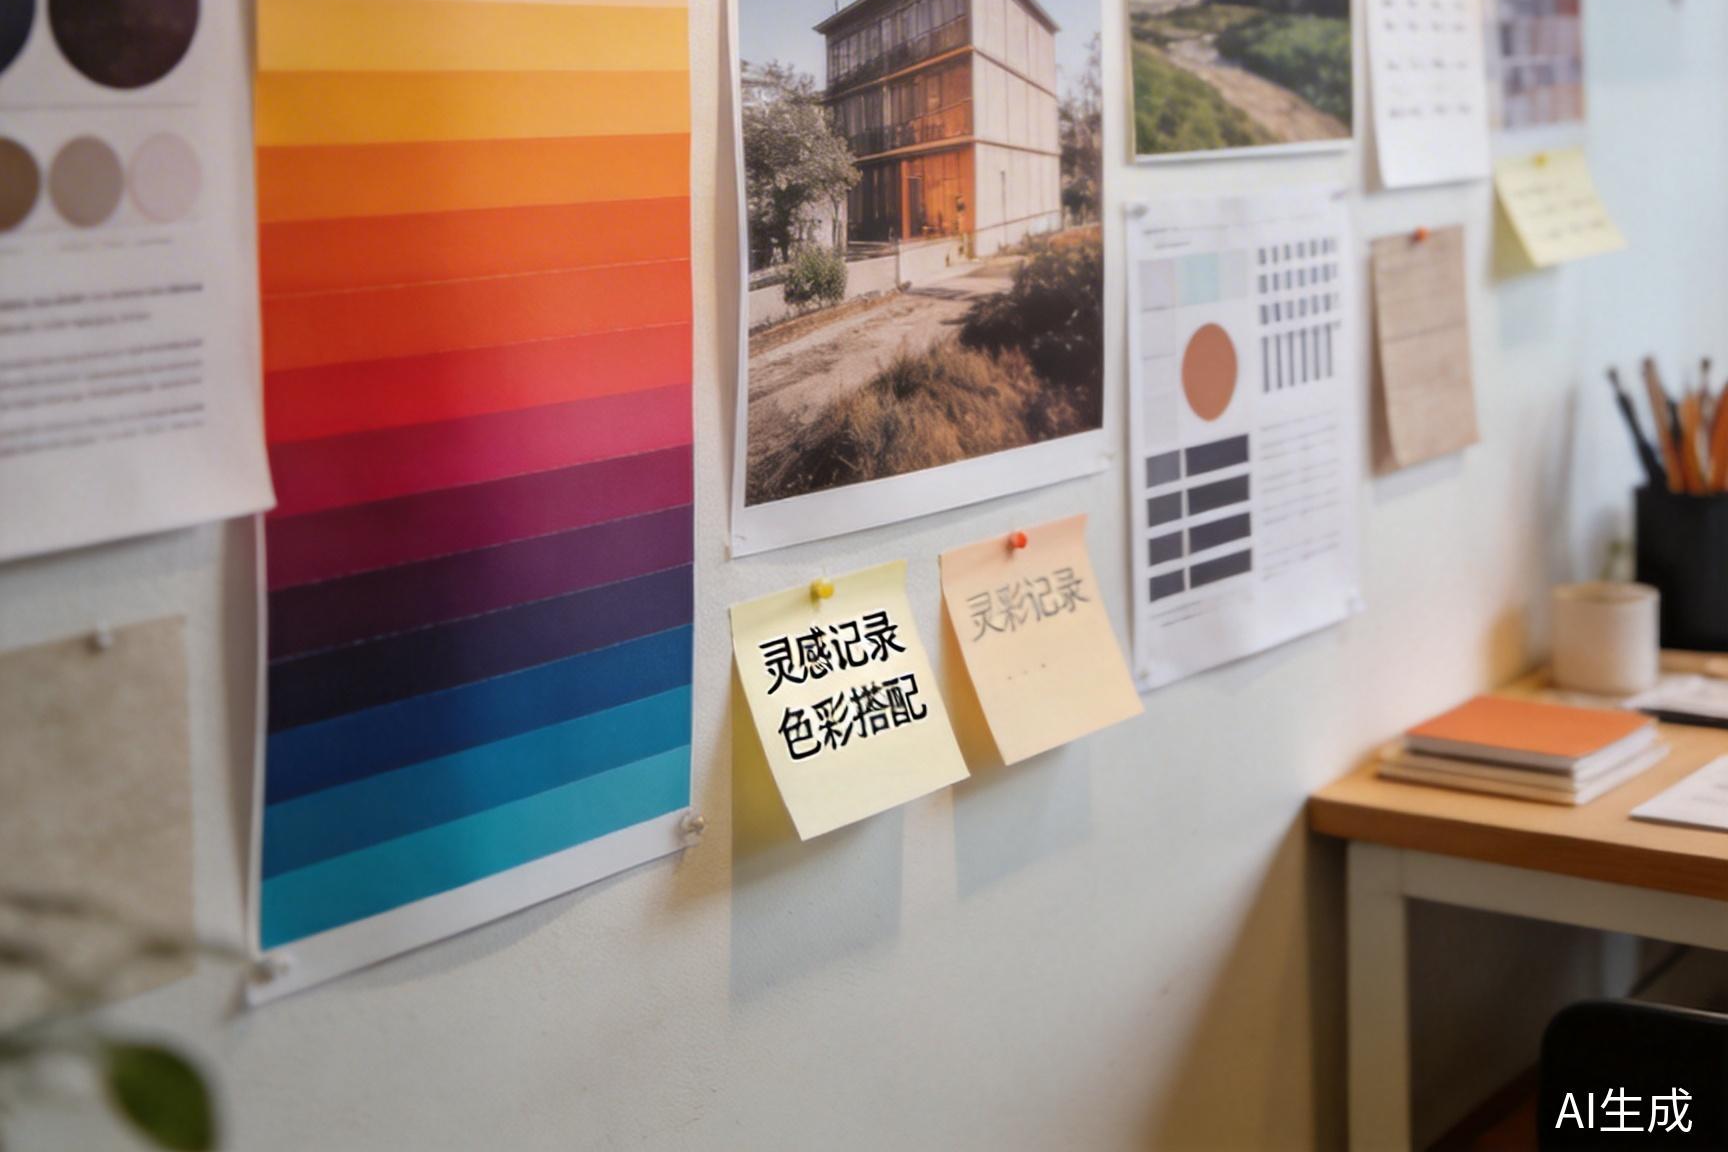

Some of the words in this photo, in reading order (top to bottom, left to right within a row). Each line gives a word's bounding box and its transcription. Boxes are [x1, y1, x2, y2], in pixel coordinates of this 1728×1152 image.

[758, 610, 907, 695] 灵感记录
[777, 673, 928, 761] 色彩搭配
